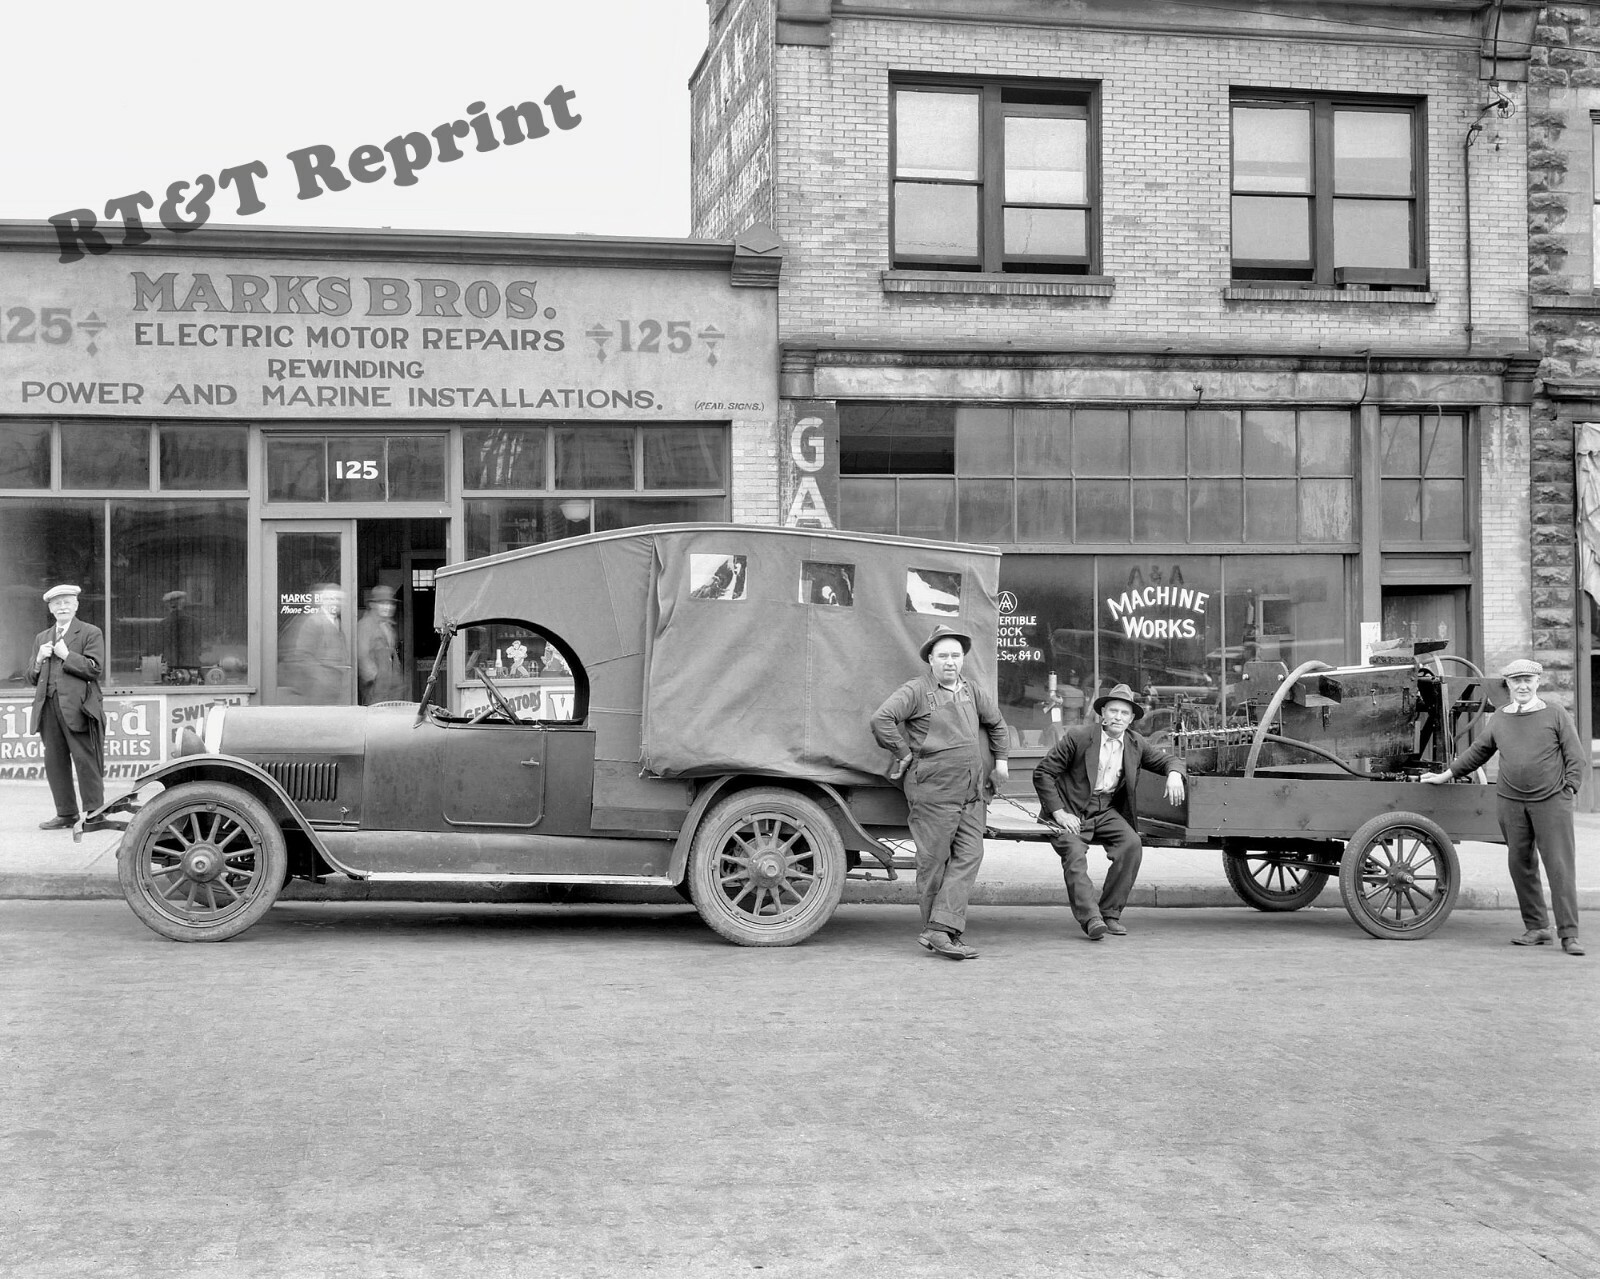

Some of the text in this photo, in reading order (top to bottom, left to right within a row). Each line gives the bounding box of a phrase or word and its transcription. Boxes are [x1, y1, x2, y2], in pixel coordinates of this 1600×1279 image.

[130, 271, 557, 320] MARKS BROS.
[0, 306, 73, 344] 25
[135, 323, 565, 352] ELECTRIC MOTOR REPAIRS
[617, 319, 693, 354] 125
[268, 358, 425, 381] REWINDING
[21, 381, 664, 411] POWER AND MARINE INSTALLATIONS.
[336, 460, 379, 480] 125
[280, 593, 313, 603] MARKS
[1107, 586, 1210, 620] MACHINE
[999, 615, 1037, 626] ERTIBLE
[1122, 616, 1196, 639] WORKS
[997, 637, 1029, 647] RILLS.
